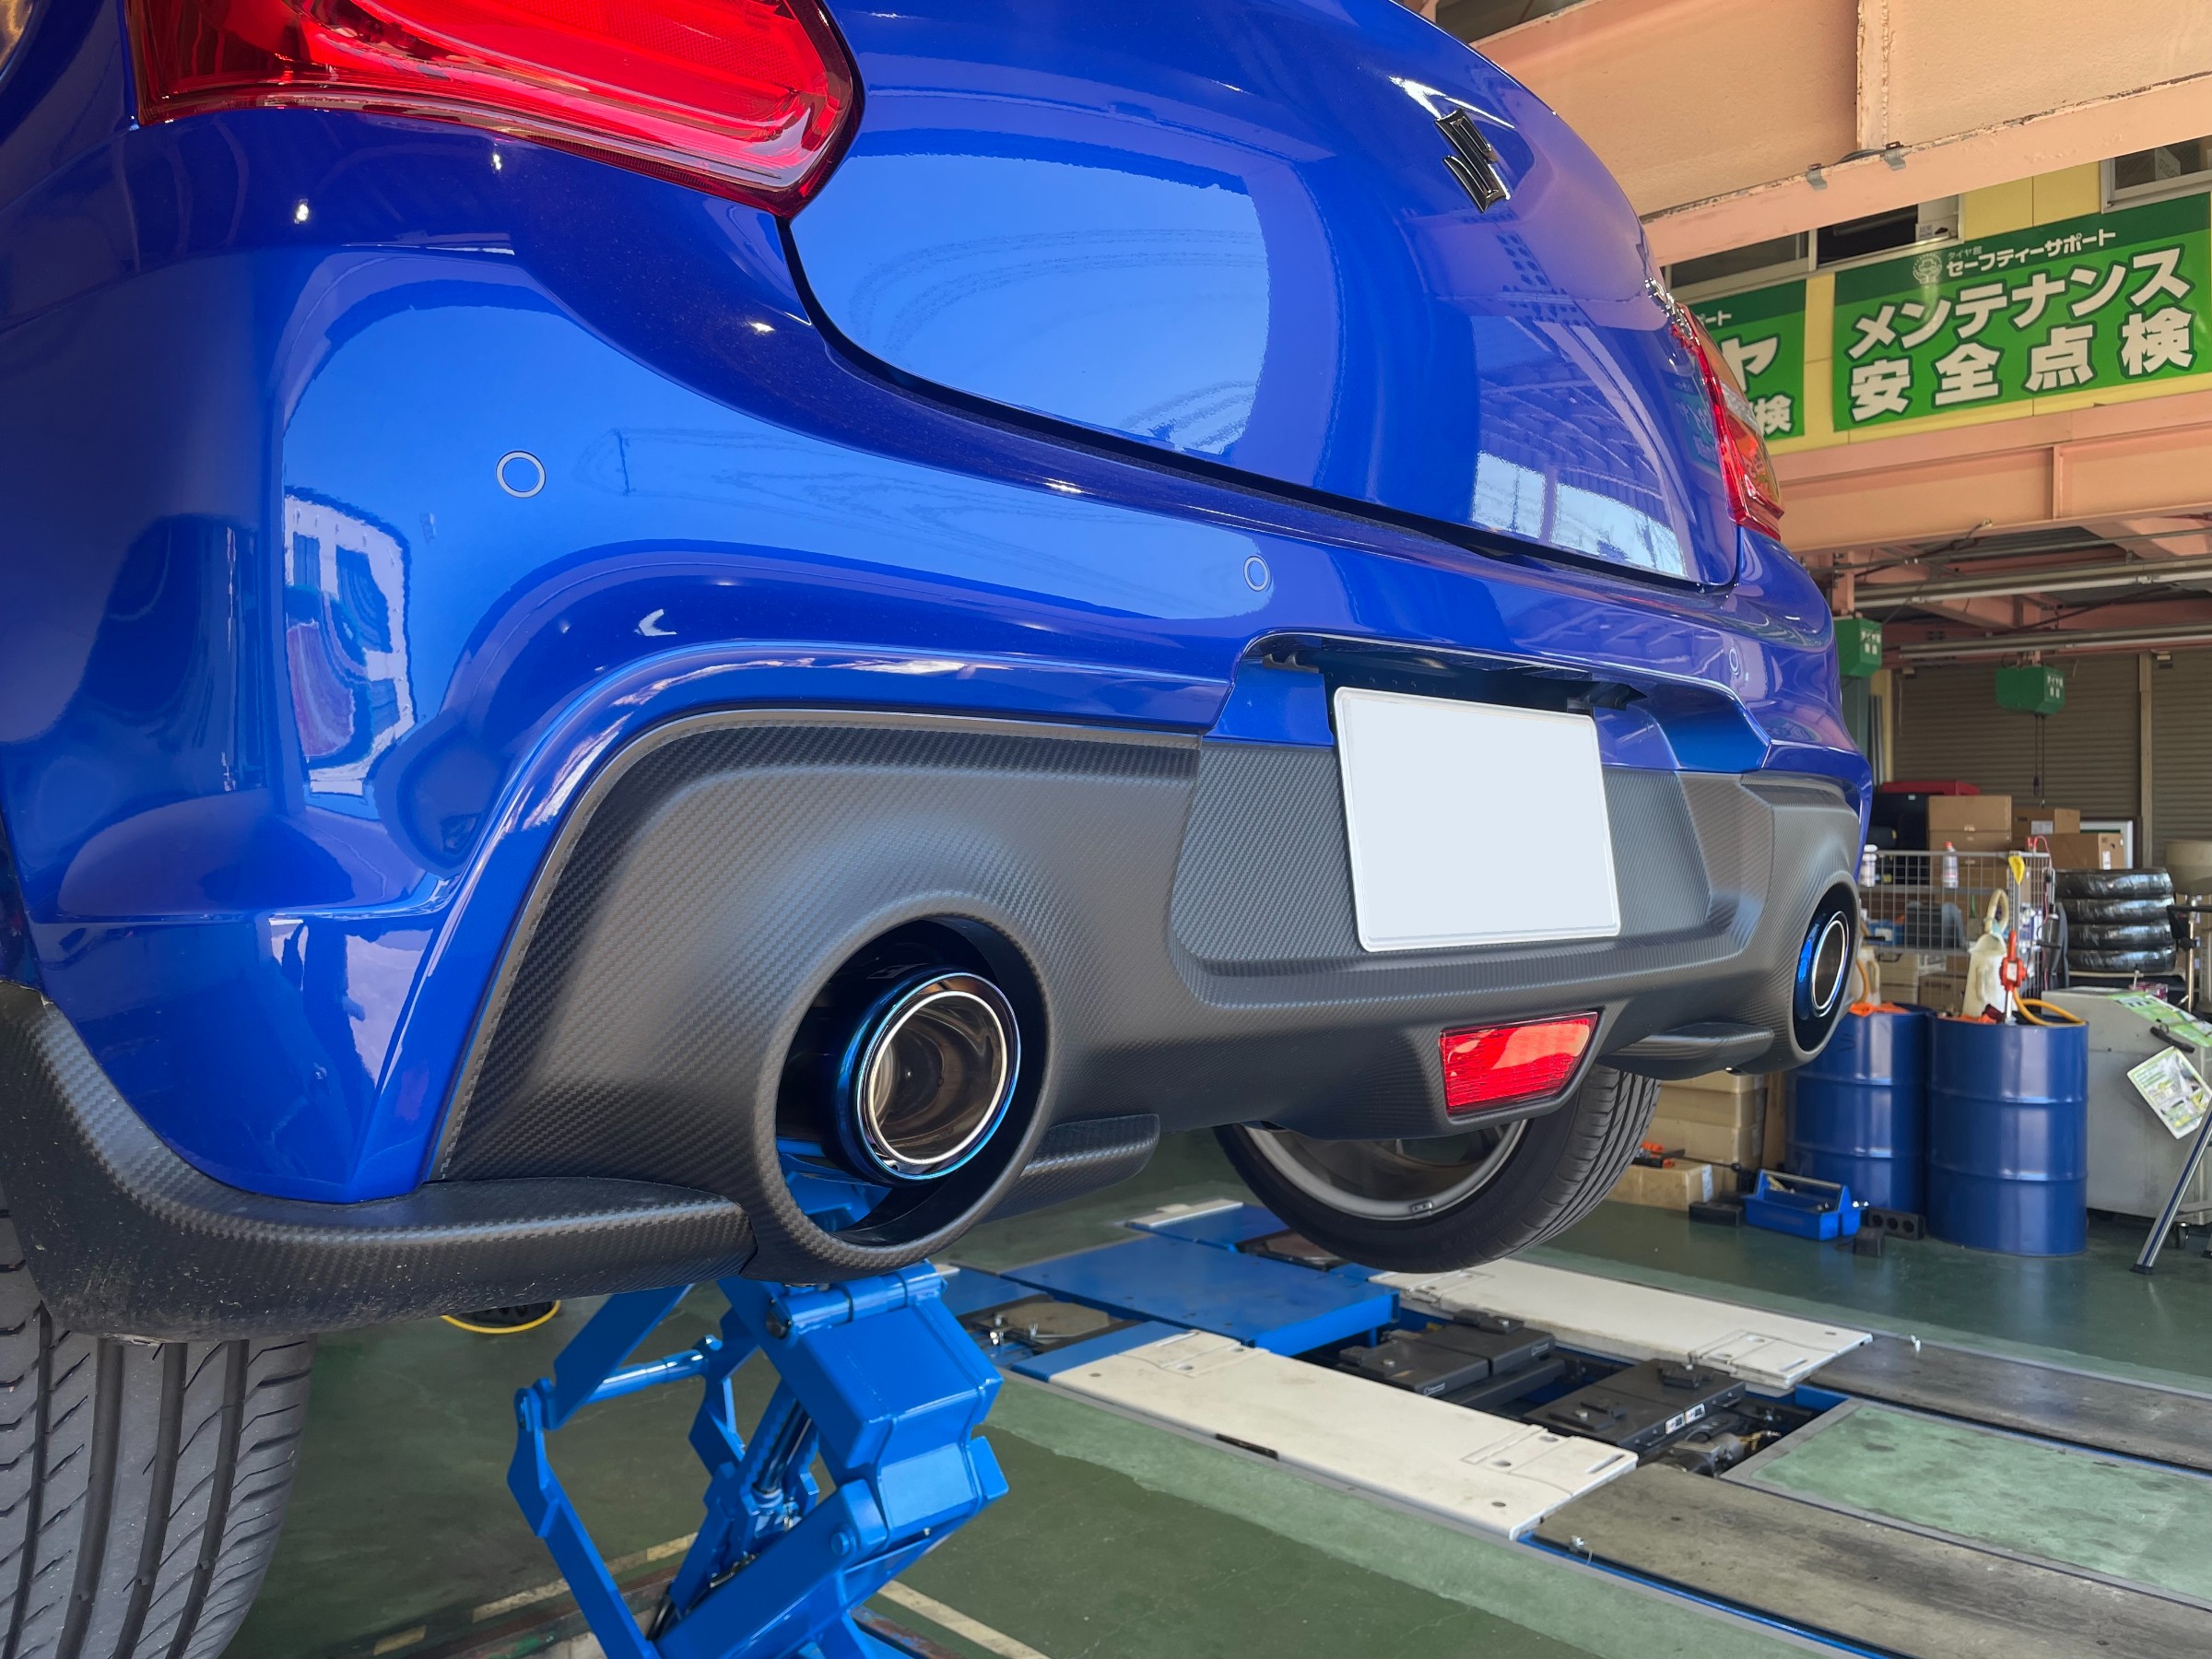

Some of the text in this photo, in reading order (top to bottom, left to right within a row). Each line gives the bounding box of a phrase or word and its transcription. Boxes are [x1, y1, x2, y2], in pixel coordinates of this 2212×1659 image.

[1848, 247, 2191, 360] メンテナンス
[1947, 229, 2116, 277] セーフティーサポート
[1850, 308, 2194, 422] 安全点検
